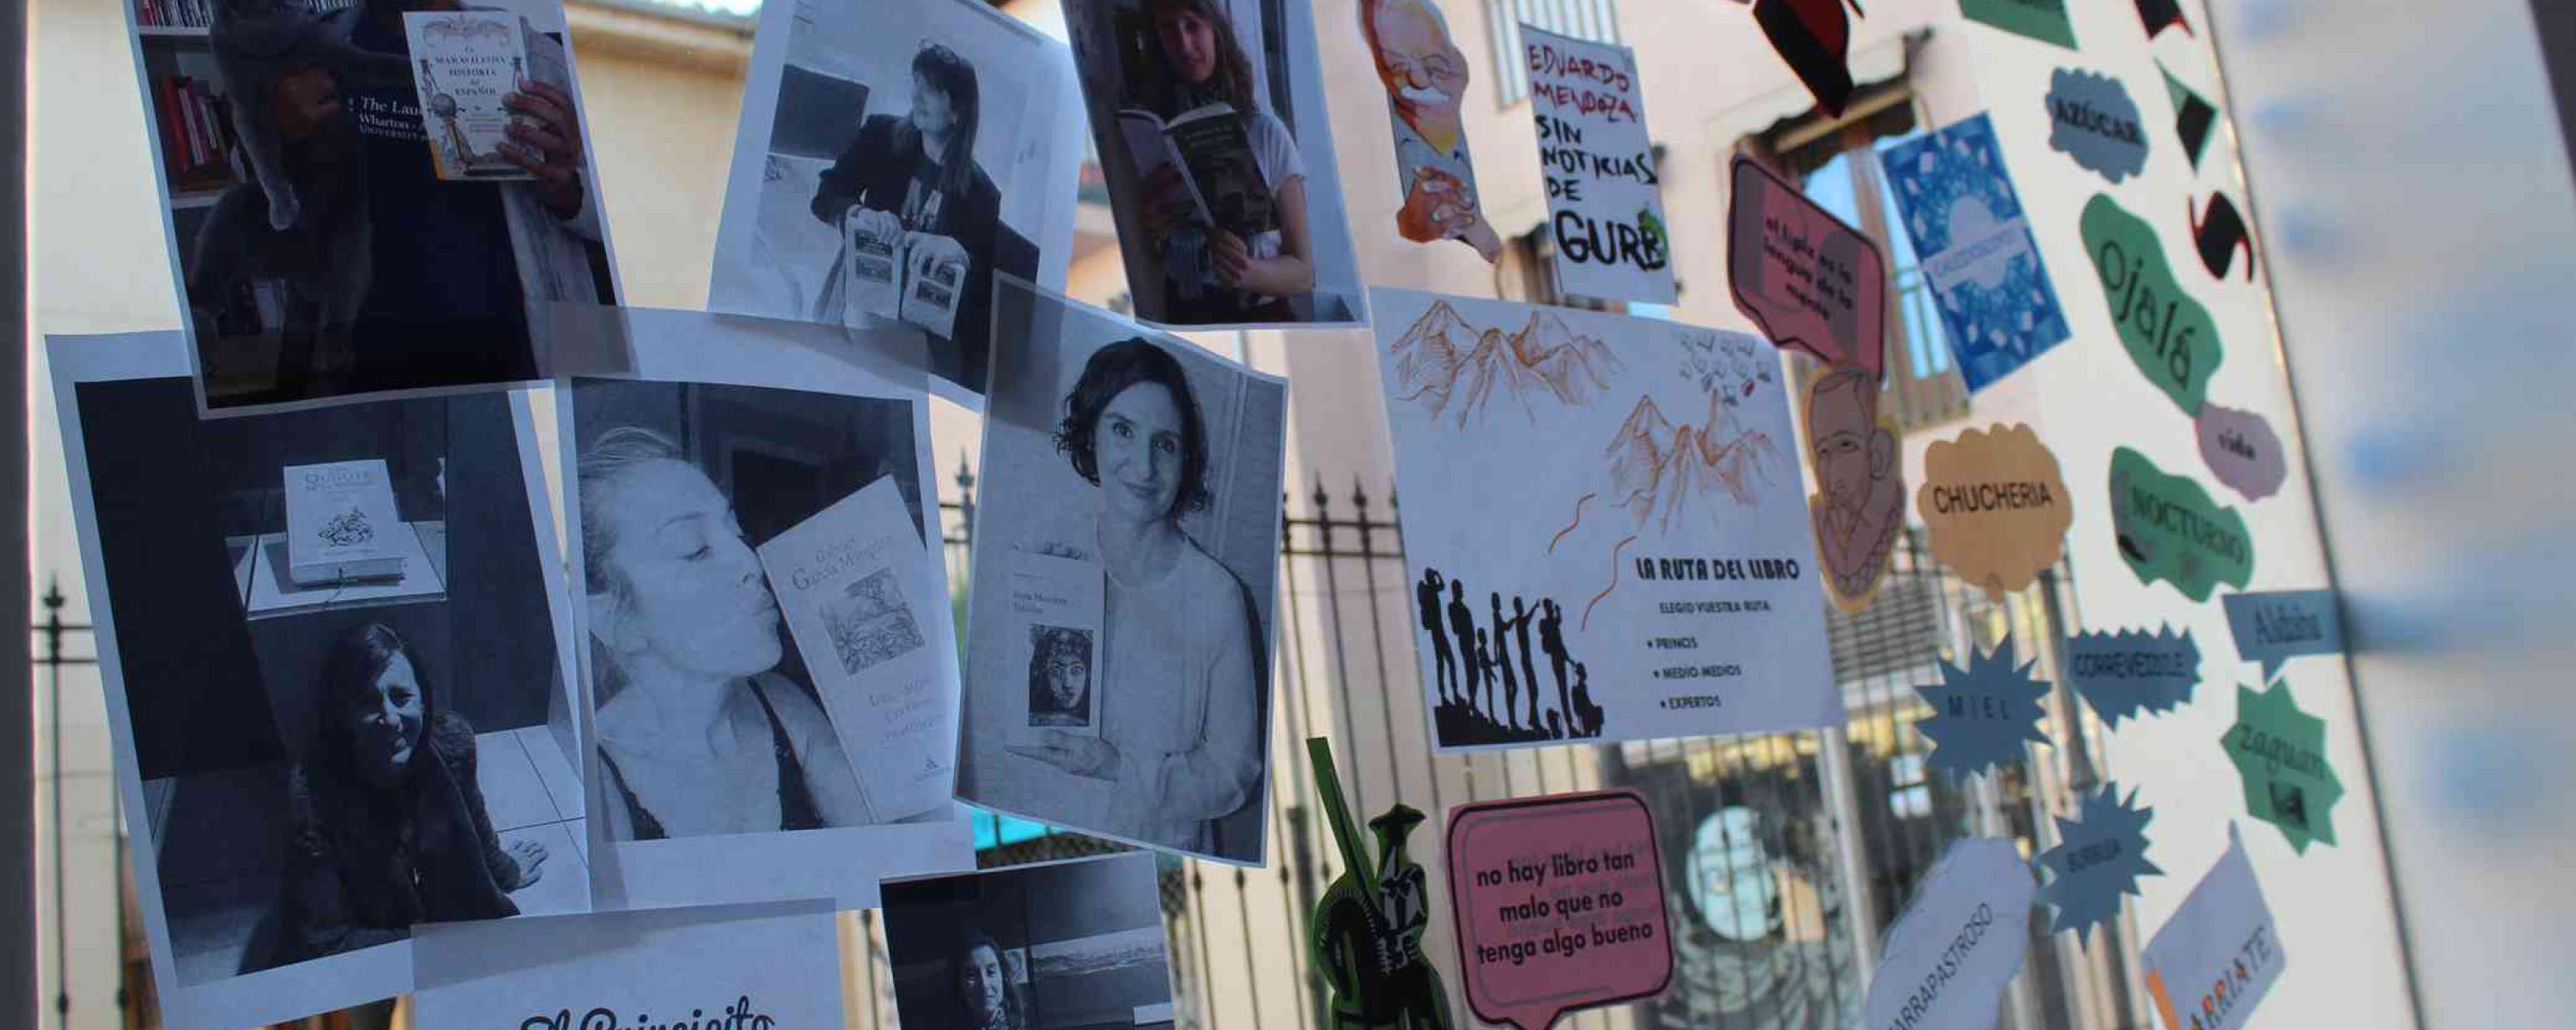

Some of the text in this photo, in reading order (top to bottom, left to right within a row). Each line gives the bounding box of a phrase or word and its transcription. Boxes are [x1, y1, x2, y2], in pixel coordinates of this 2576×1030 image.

[1528, 45, 1630, 93] EDUARDO
[361, 95, 421, 115] The Lau
[1534, 81, 1637, 124] MENDOZA
[1534, 114, 1582, 144] SIN
[1540, 147, 1659, 185] NOTICIAS
[1546, 176, 1583, 202] DE
[2100, 240, 2196, 392] Ojalá
[1636, 557, 1800, 581] LA RUTA DEL LIBRO
[1668, 694, 1722, 709] EXPERTOS
[1947, 694, 2012, 720] MIEL
[1477, 852, 1635, 887] no hay libro tan
[1499, 890, 1623, 923] malo que no
[1477, 923, 1653, 966] tenga algo bueno
[1889, 902, 1993, 1030] ARRAPASTROSO
[580, 995, 775, 1030] Picipito
